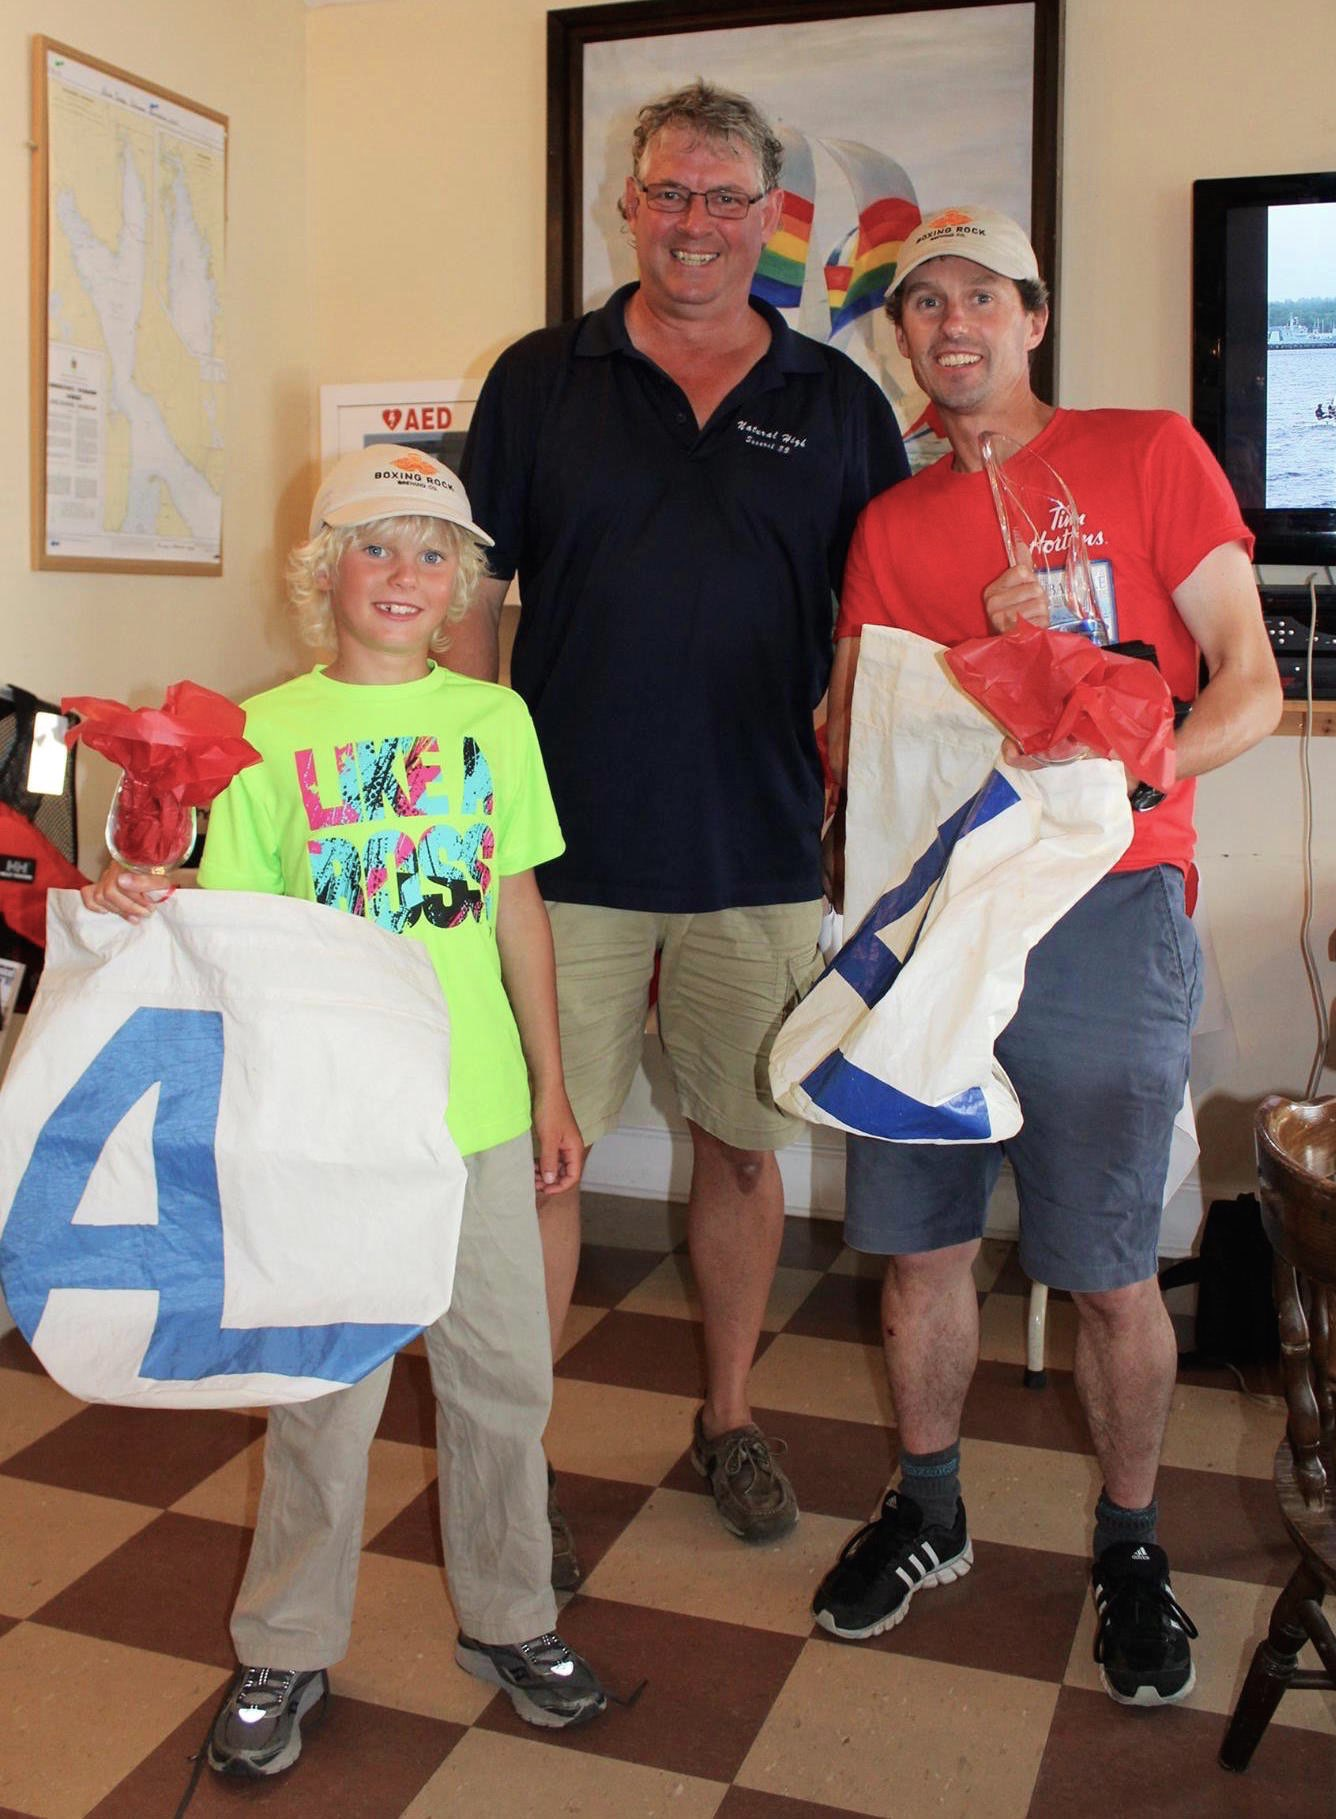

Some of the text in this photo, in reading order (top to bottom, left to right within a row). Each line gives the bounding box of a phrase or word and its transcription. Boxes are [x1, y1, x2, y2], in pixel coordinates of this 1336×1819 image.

[956, 226, 986, 236] ROCK
[404, 406, 453, 431] AED
[737, 420, 808, 448] Natural High
[374, 471, 455, 491] BOXING ROCK
[1049, 497, 1087, 531] Tim
[1029, 530, 1105, 554] Hortns
[294, 736, 494, 832] LIKE A
[307, 823, 496, 935] BOSS
